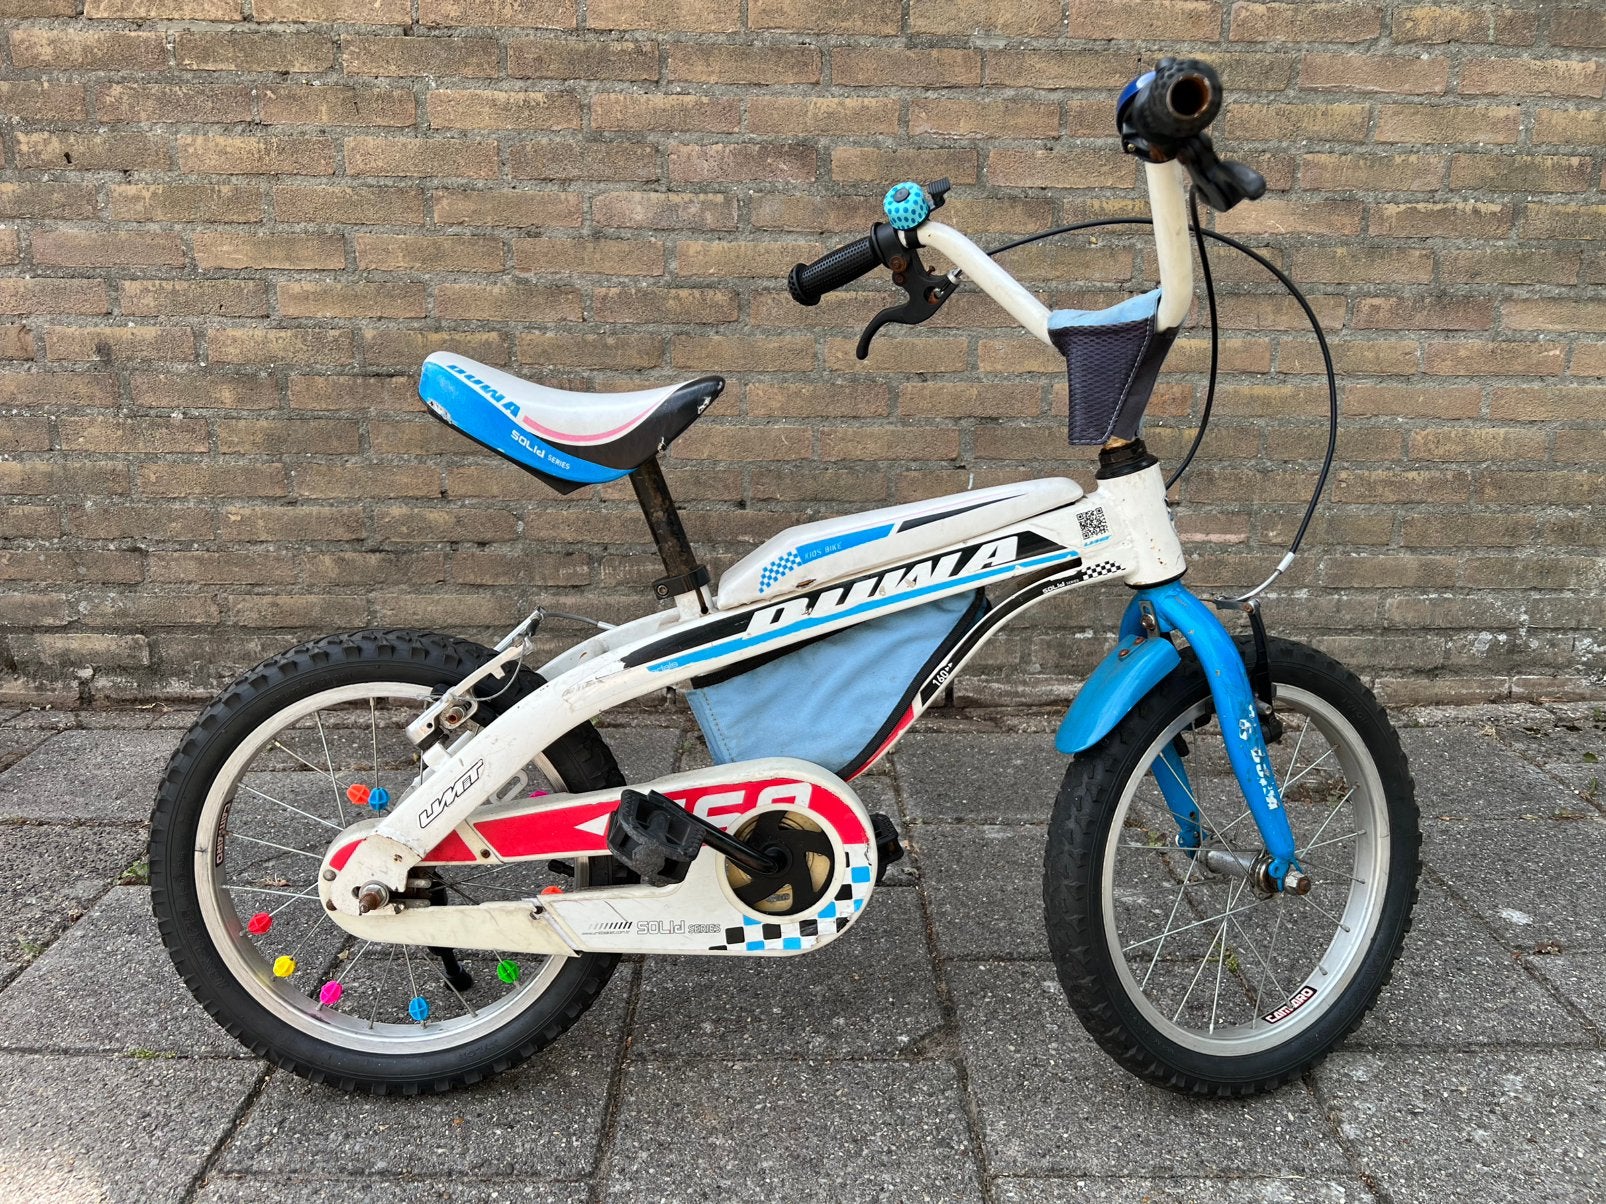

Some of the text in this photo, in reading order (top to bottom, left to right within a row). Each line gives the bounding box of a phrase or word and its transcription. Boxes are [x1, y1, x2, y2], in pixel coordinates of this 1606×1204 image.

[547, 454, 571, 470] SERIES
[804, 541, 842, 560] KIDS BIKE
[932, 670, 949, 686] 160
[687, 923, 722, 934] SERIES
